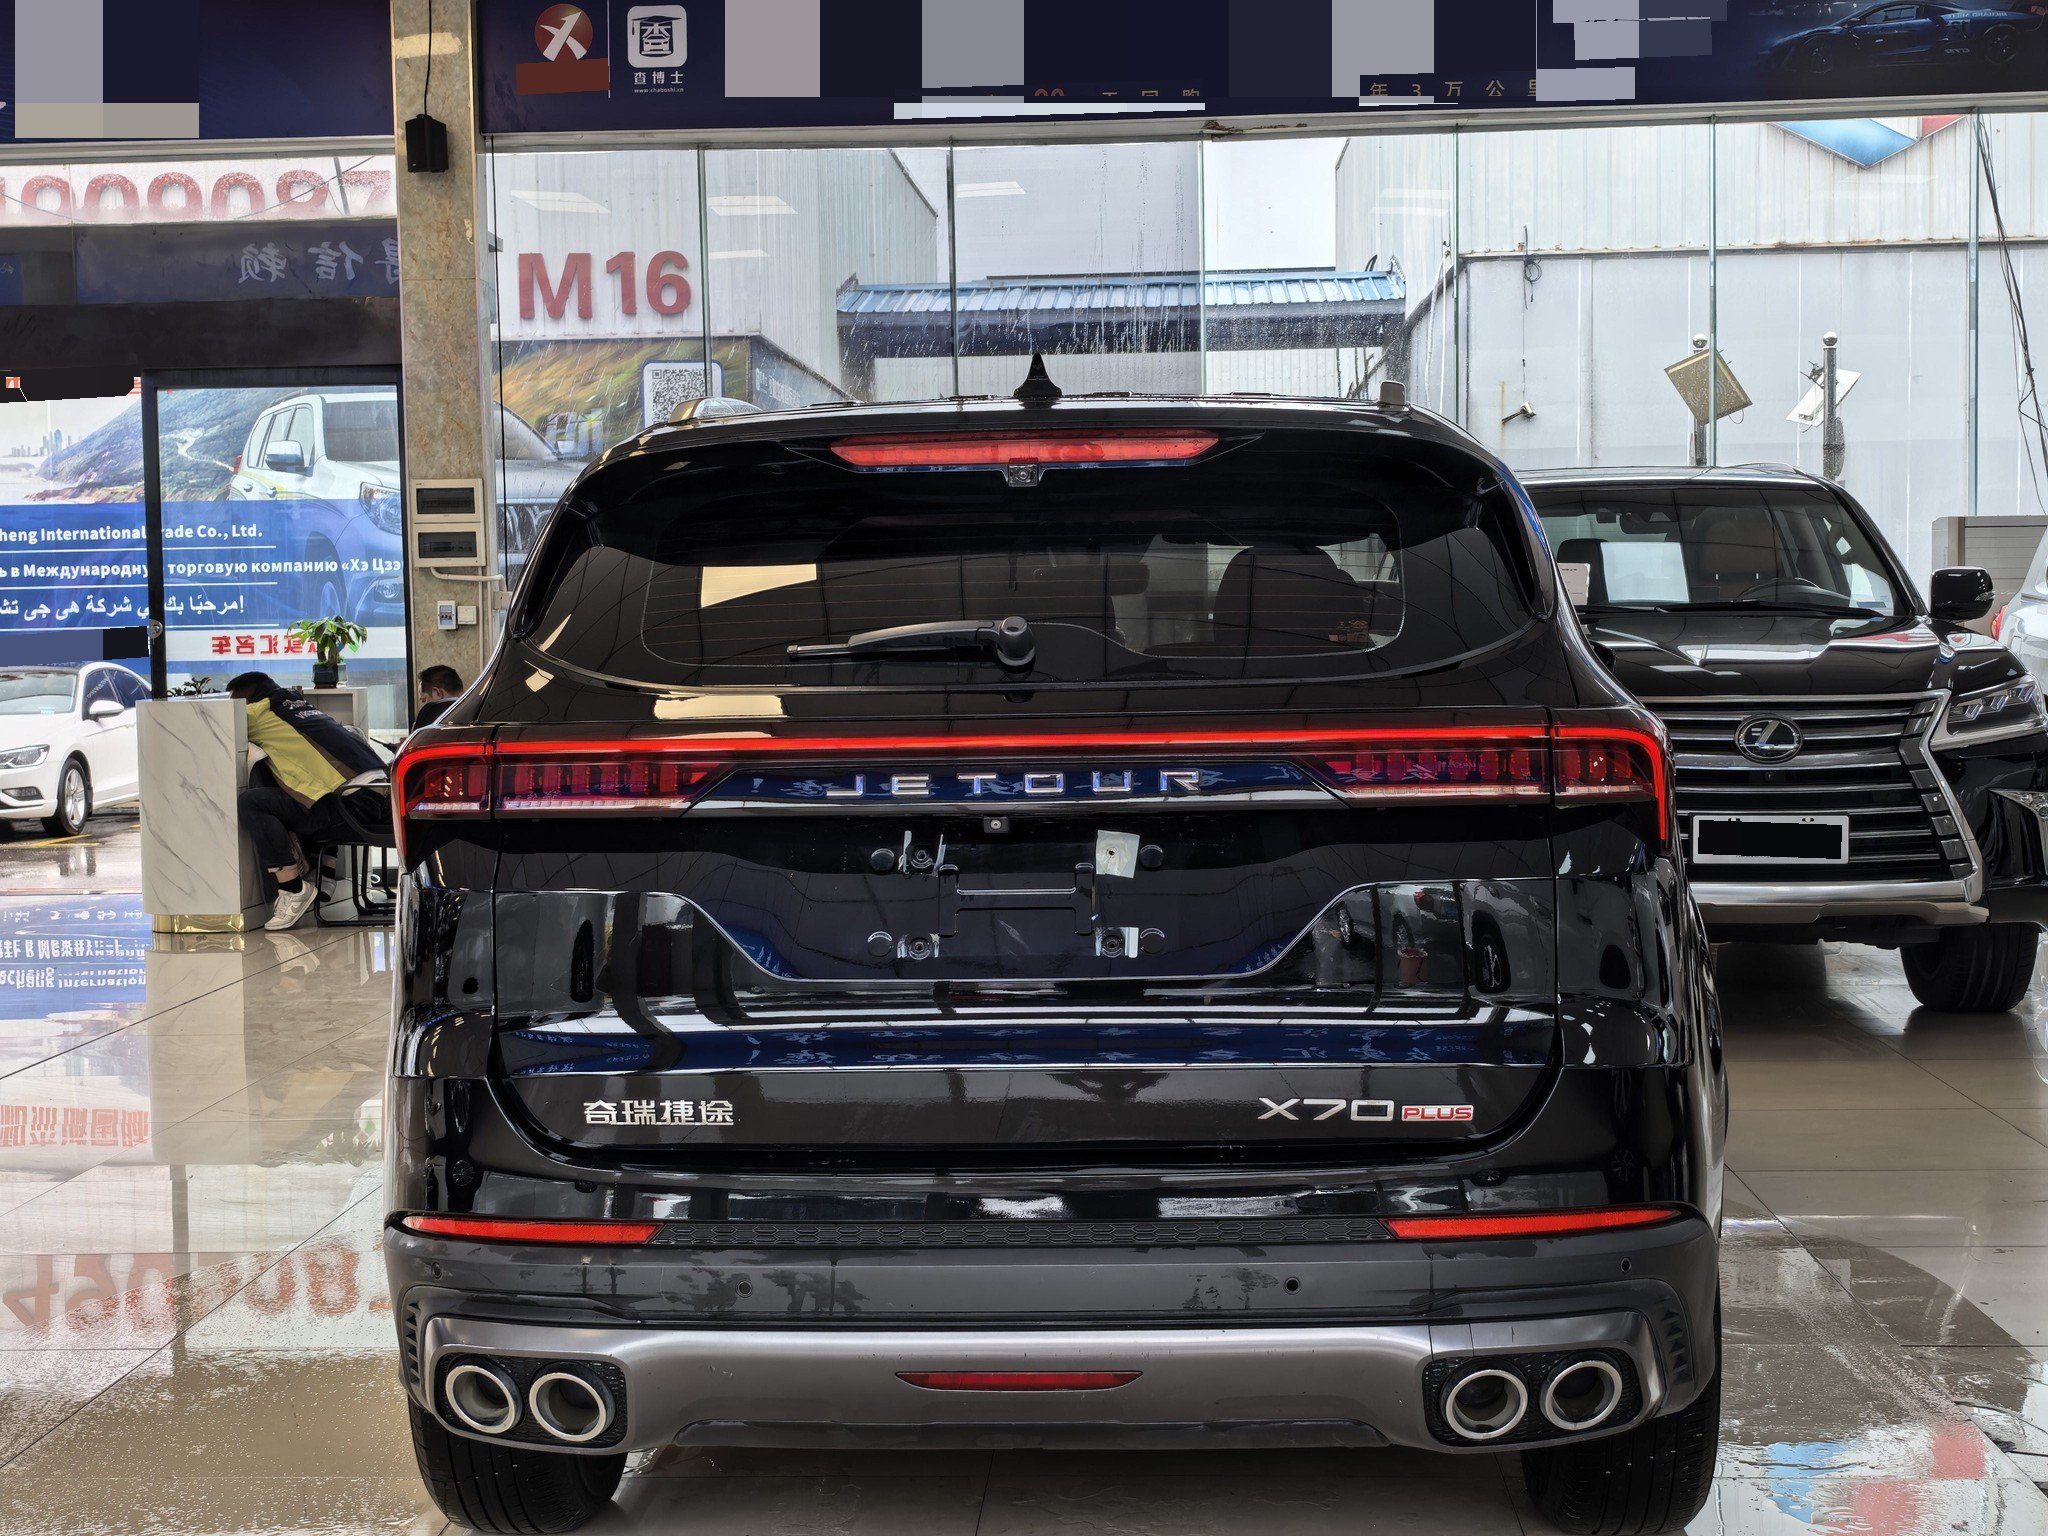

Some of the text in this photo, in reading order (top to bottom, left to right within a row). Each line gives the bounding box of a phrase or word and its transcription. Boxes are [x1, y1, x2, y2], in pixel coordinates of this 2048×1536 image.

[633, 71, 684, 85] 查博士
[41, 525, 147, 541] International
[196, 524, 229, 541] Co.,
[231, 523, 263, 538] Ltd.
[23, 563, 149, 580] Международну
[167, 561, 248, 577] торговую
[251, 560, 338, 574] компанию
[372, 557, 404, 575] Цзэ
[85, 594, 133, 618] شركة
[826, 768, 1201, 798] JETOUR
[583, 1099, 734, 1126] 奇瑞捷途
[1257, 1097, 1473, 1121] X70 PLUS
